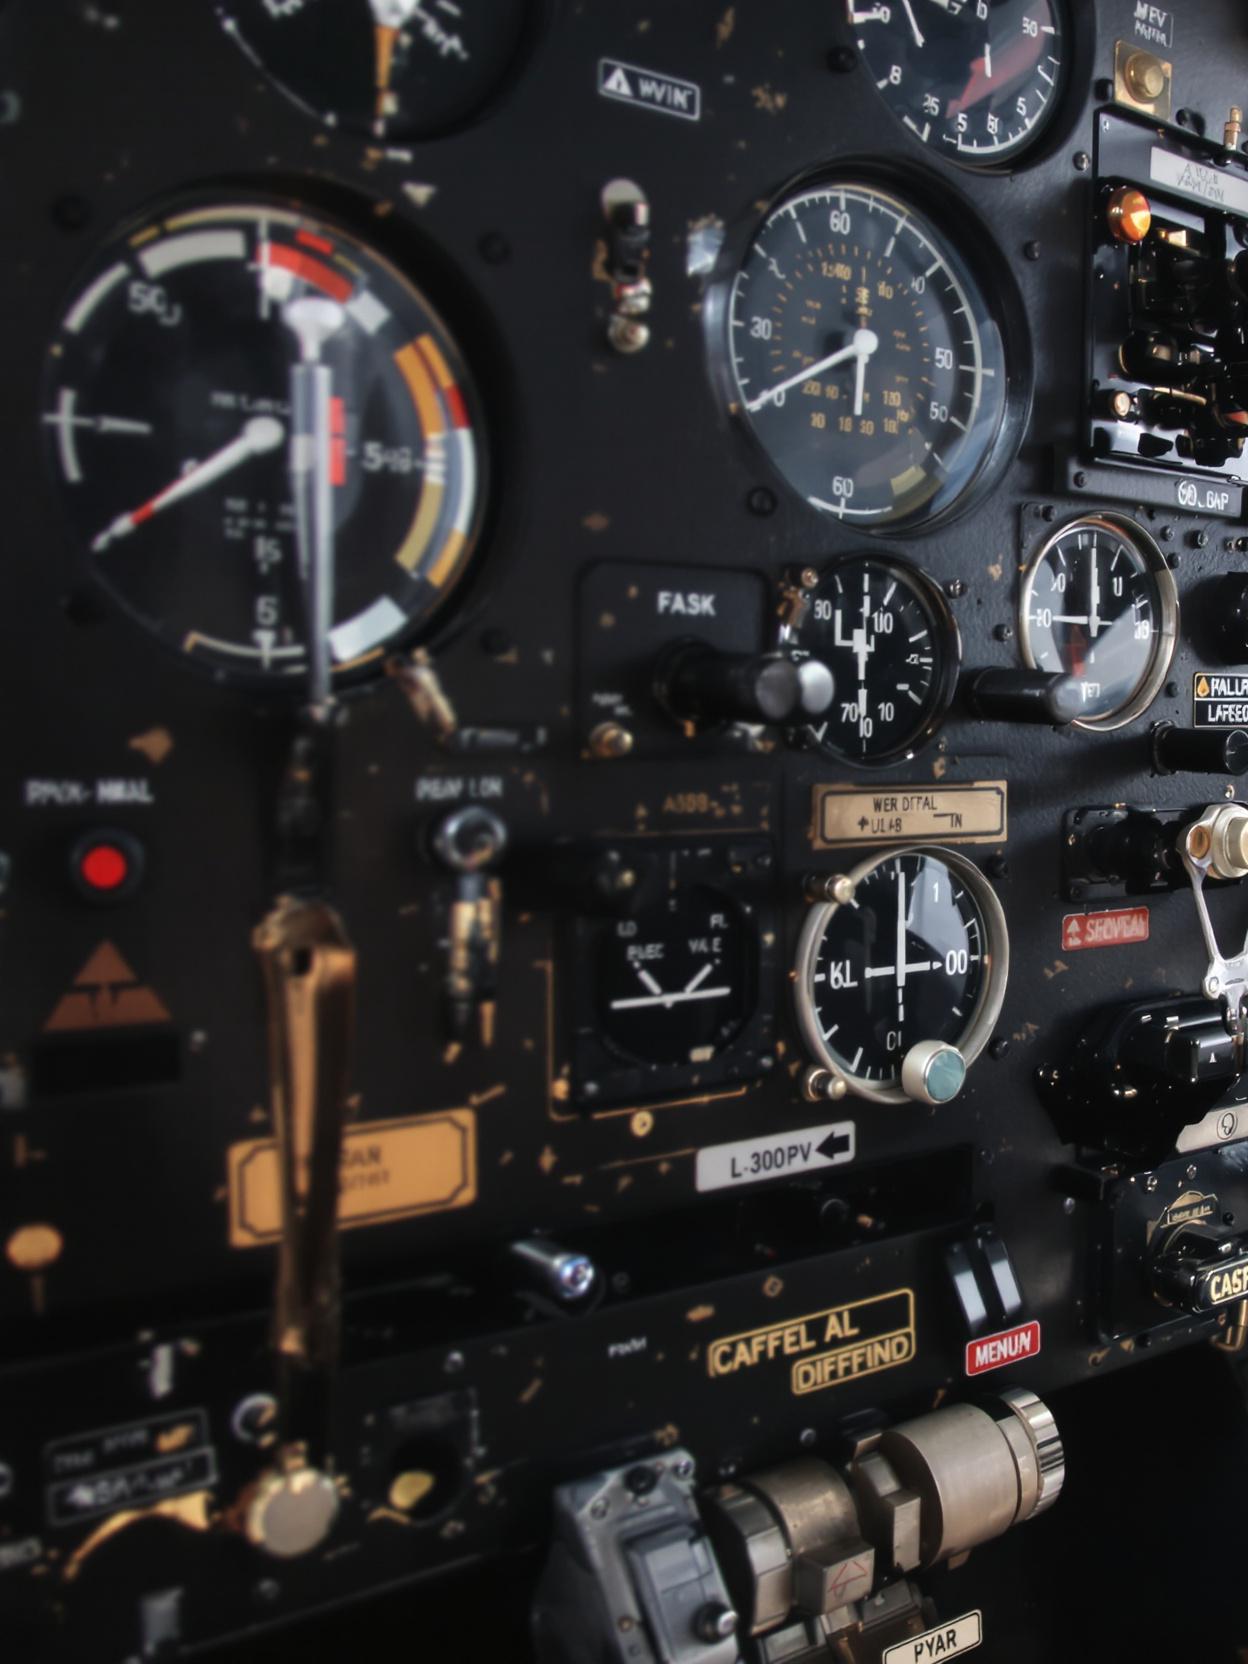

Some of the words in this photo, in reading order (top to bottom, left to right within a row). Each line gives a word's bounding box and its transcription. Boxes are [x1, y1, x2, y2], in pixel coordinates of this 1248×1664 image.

[890, 65, 902, 85] 8
[1017, 97, 1027, 116] 5
[957, 113, 968, 132] 5
[829, 210, 850, 234] 60
[750, 316, 772, 340] 30
[934, 347, 953, 369] 50
[832, 476, 854, 498] 60
[657, 591, 716, 617] FASK
[840, 702, 859, 723] 70
[877, 702, 894, 722] 10
[714, 1323, 817, 1375] CAFFEL
[824, 1310, 860, 1343] AL
[914, 1629, 957, 1663] PYAR
